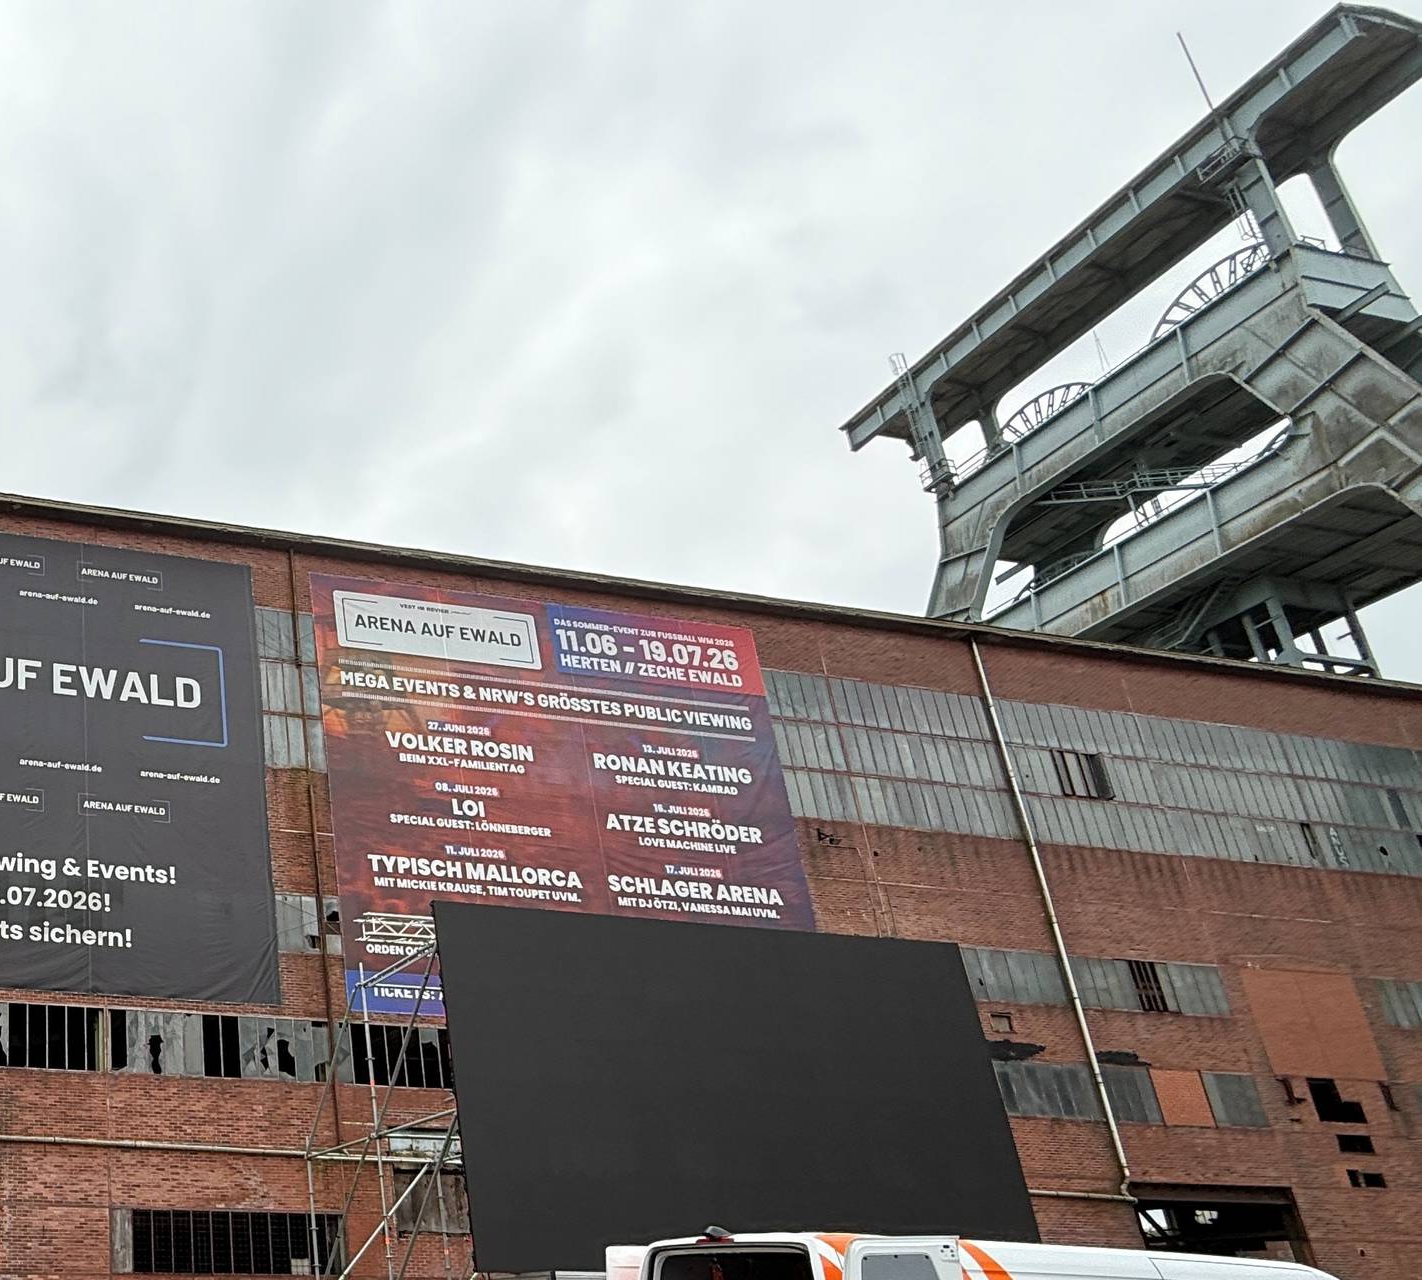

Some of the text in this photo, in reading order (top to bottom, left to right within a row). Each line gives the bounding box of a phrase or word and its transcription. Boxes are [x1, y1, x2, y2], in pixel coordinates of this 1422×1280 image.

[10, 558, 41, 569] EWALD
[81, 568, 158, 585] ARENA AUF EWALD
[19, 589, 98, 606] arena-auf-ewald.de
[134, 603, 211, 619] arena-auf-ewald.de
[354, 614, 522, 647] ARENA AUF EWALD
[553, 618, 734, 648] DAS SOMMER-EVENT ZUR FUSSBALL WM 2026
[556, 628, 618, 656] 11.06
[639, 639, 739, 670] 19.07.26
[560, 653, 621, 673] HERTEN
[637, 663, 686, 681] ZECHE
[688, 669, 743, 687] EWALD
[52, 663, 201, 709] EWALD
[340, 671, 390, 690] MEGA
[392, 677, 460, 698] EVENTS
[463, 685, 477, 700] &
[538, 692, 622, 716] GRÖSSTES
[624, 704, 682, 724] PUBLIC
[683, 710, 752, 731] VIEWING
[427, 721, 442, 731] 27.
[442, 724, 465, 734] JUNI
[385, 731, 534, 762] VOLKER ROSIN
[642, 744, 656, 754] 13.
[656, 746, 676, 756] JULI
[19, 757, 102, 773] arena-auf-ewald.de
[399, 753, 525, 774] BEIM XXL-FAMILIENTAG
[593, 753, 753, 784] RONAN KEATING
[140, 770, 220, 784] arena-auf-ewald.de
[615, 774, 738, 796] SPECIAL GUEST: KAMRAD
[6, 793, 39, 804] EWALD
[452, 784, 474, 794] JULI
[83, 800, 165, 816] ARENA AUF EWALD
[451, 798, 486, 818] LOI
[668, 805, 687, 815] JULI
[389, 813, 552, 837] SPECIAL GUEST: LÖNNEBERGER
[606, 813, 763, 844] ATZE SCHRÖDER
[457, 847, 480, 857] JULI
[639, 836, 736, 854] LOVE MACHINE LIVE
[62, 857, 82, 877] &
[87, 859, 176, 885] Events!
[367, 854, 583, 889] TYPISCH MALLORCA
[664, 865, 678, 875] 17.
[678, 866, 698, 876] JULI
[373, 876, 582, 903] MIT MICKIE KRAUSE, TIM TOUPET UVM.
[607, 874, 784, 906] SCHLAGER ARENA
[618, 896, 638, 907] MIT
[639, 897, 653, 908] DJ
[681, 901, 731, 915] VANESSA
[732, 906, 752, 917] MAI
[753, 908, 781, 919] UVM.
[29, 921, 132, 948] sichern!
[365, 943, 404, 955] ORDEN
